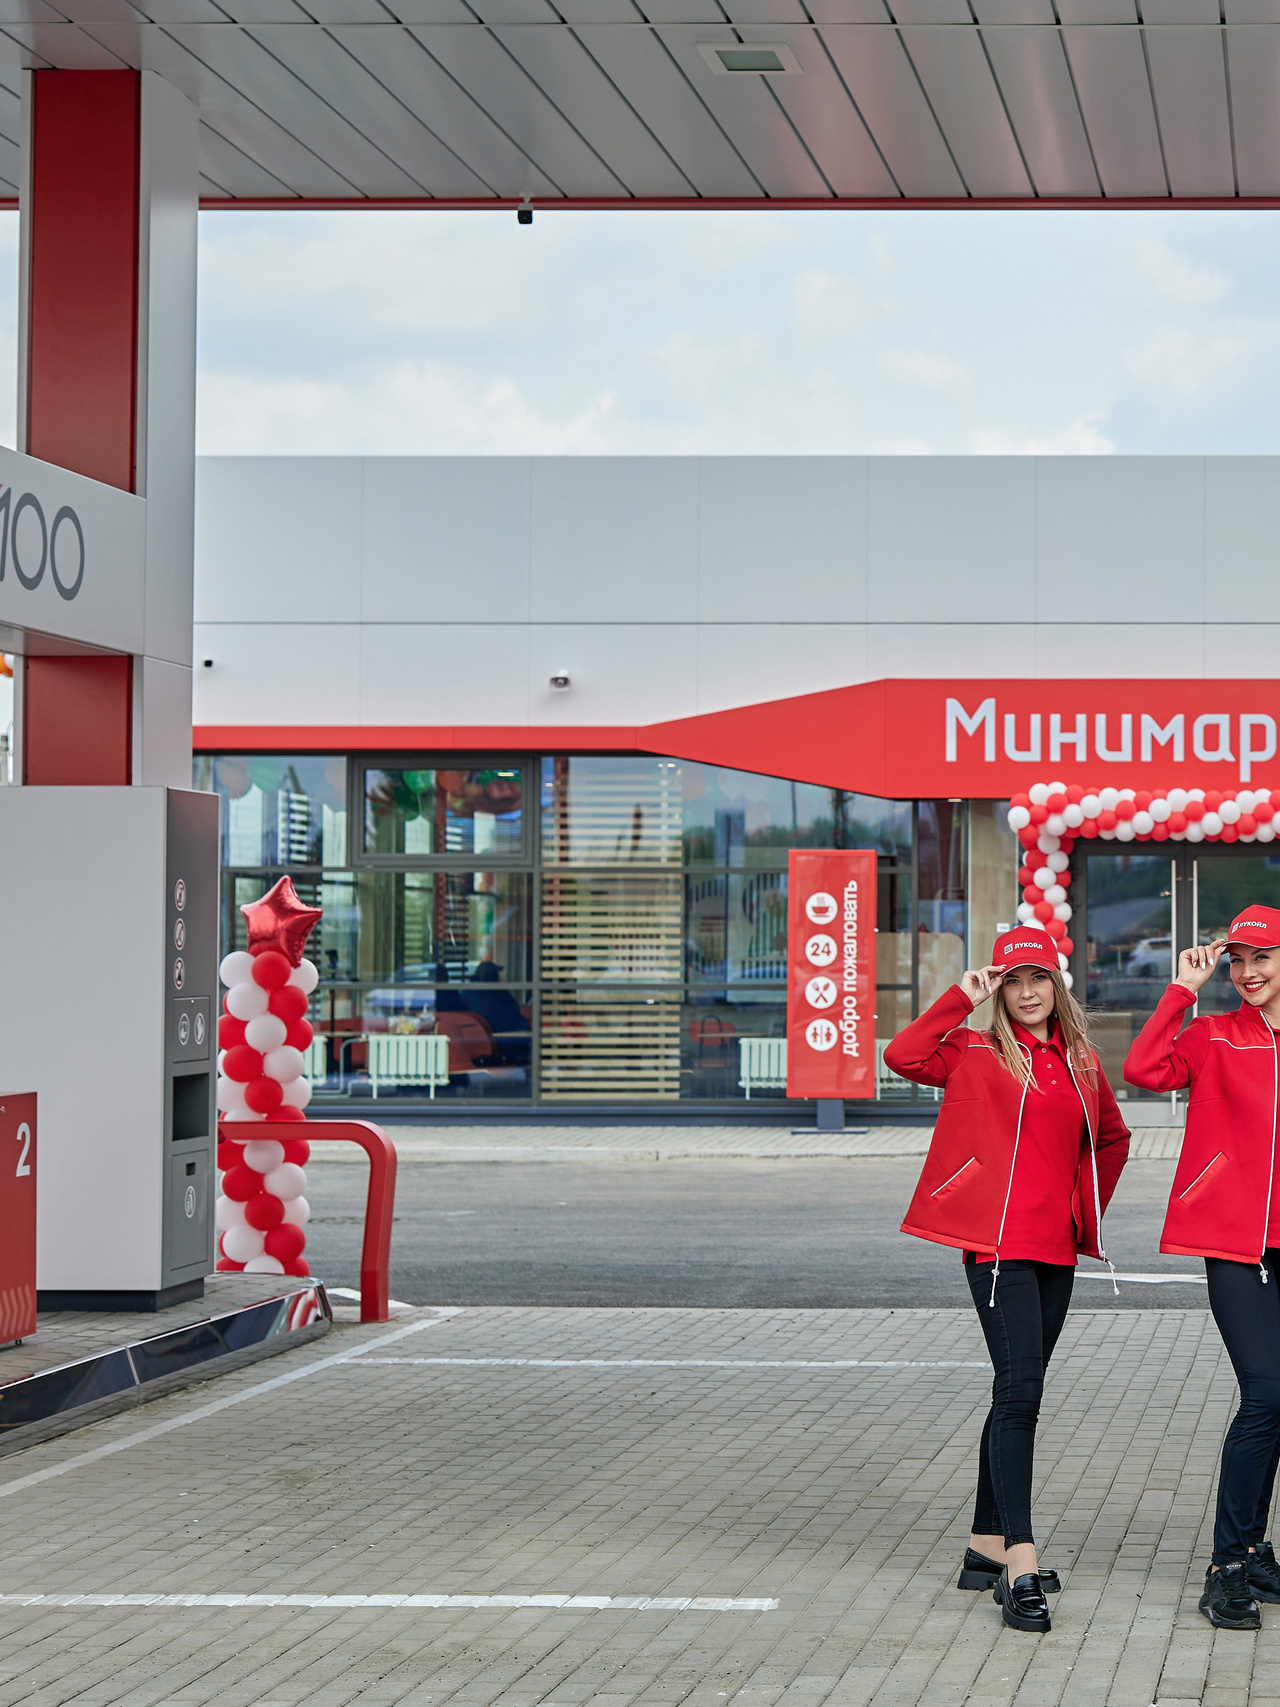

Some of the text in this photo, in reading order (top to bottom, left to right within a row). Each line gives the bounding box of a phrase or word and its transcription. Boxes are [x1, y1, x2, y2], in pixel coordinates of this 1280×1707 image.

[0, 487, 85, 601] 100
[811, 942, 831, 957] 24
[839, 879, 861, 1058] добро пожаловать
[15, 1122, 31, 1177] 2
